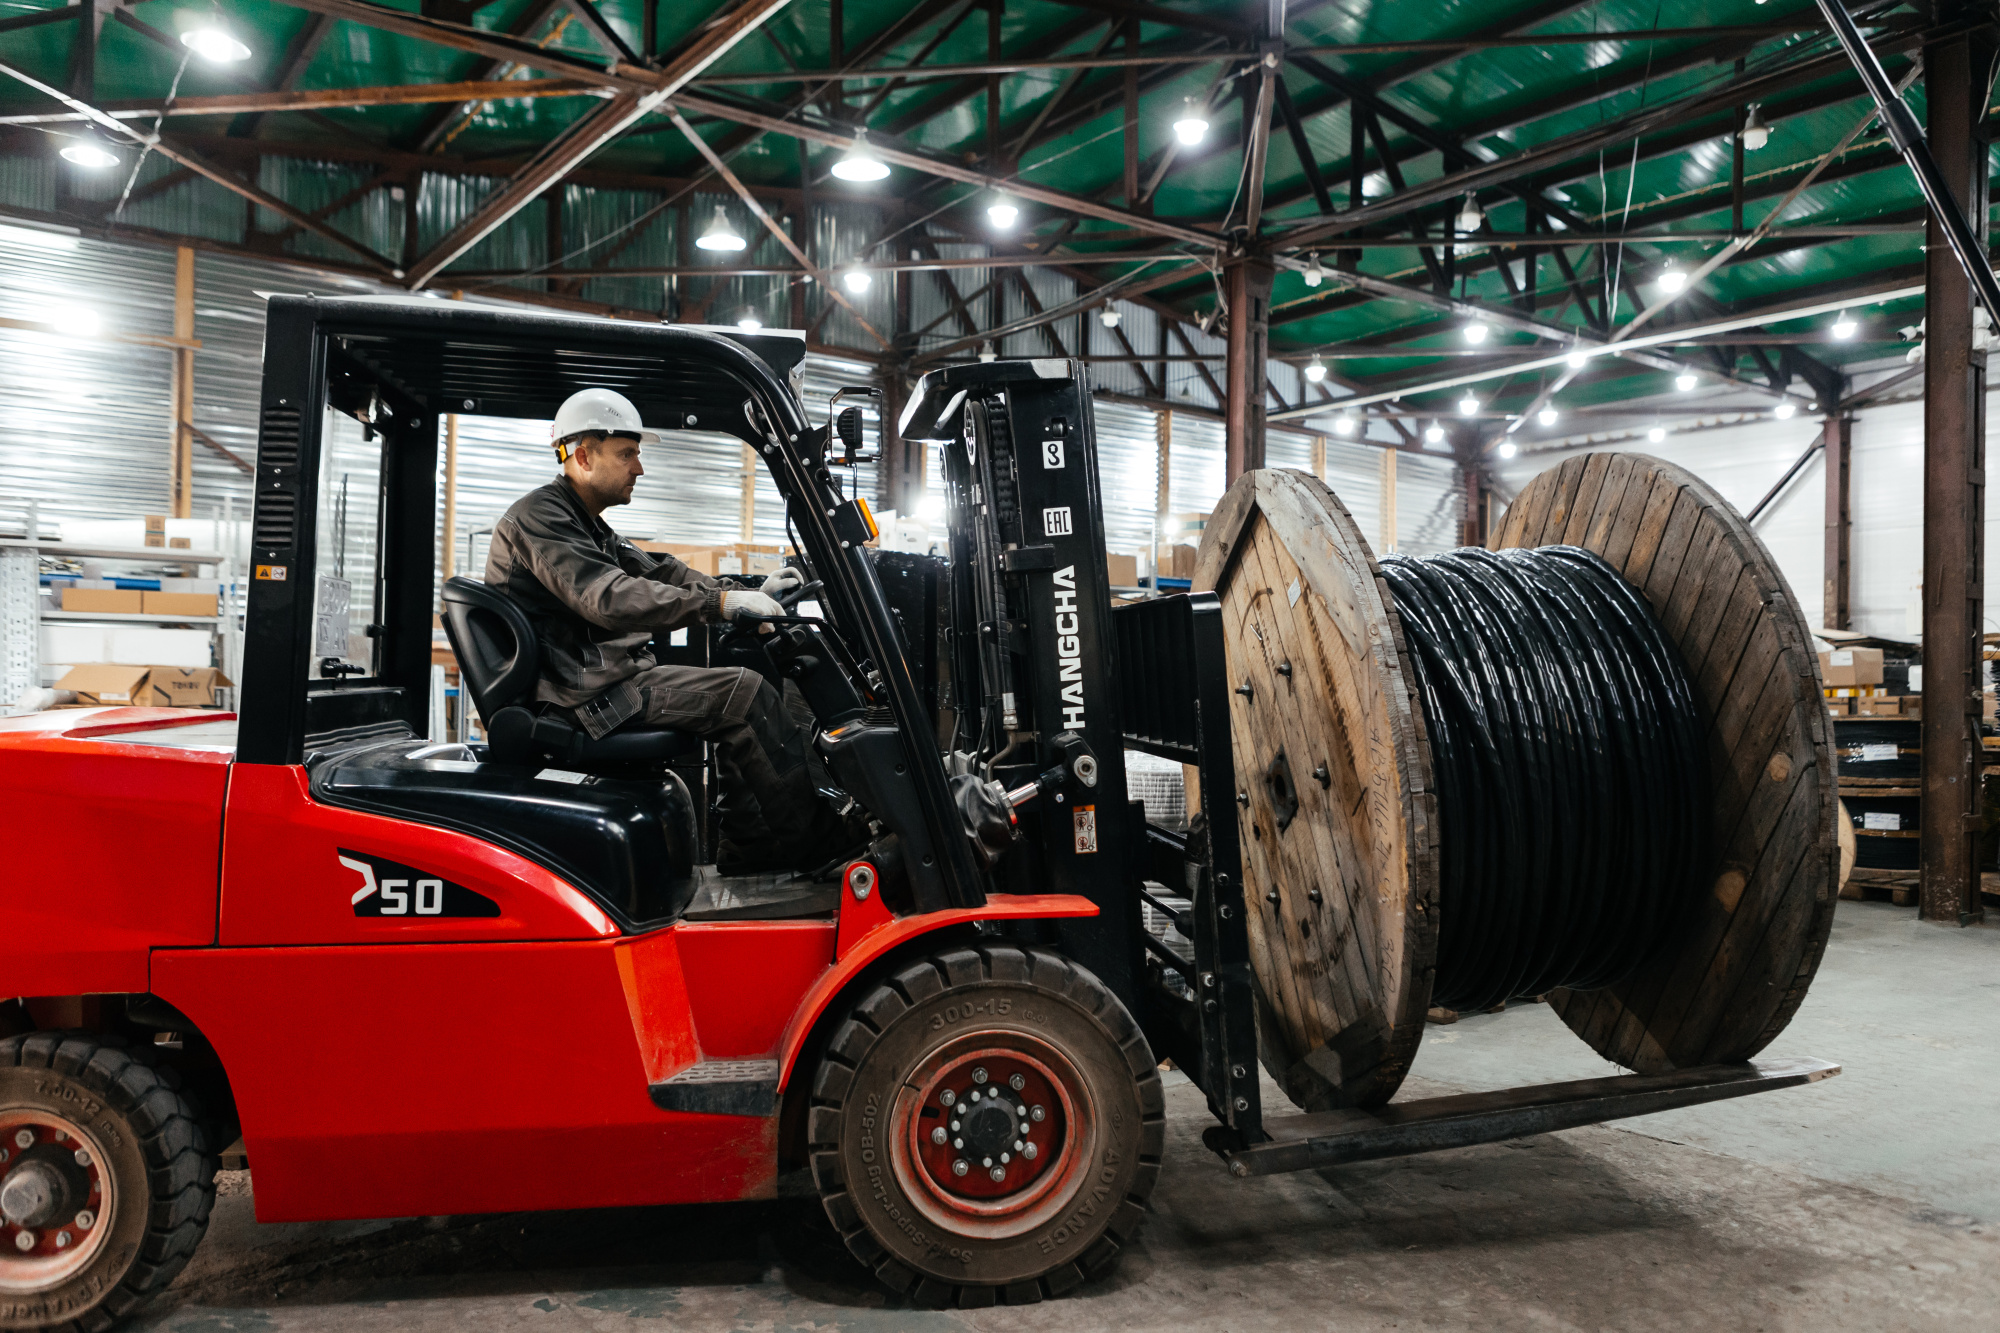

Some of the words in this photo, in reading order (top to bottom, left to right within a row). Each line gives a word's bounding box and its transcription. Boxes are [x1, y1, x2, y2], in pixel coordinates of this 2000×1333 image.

[1046, 511, 1069, 533] EAC
[1053, 565, 1085, 729] HANGCHA
[380, 879, 443, 914] 50
[931, 998, 1012, 1030] 300-15
[35, 1080, 101, 1117] 7.00-12
[861, 1093, 879, 1163] OB-502
[868, 1165, 973, 1263] Soid-Super-Lug
[1038, 1148, 1120, 1254] ADVANCE
